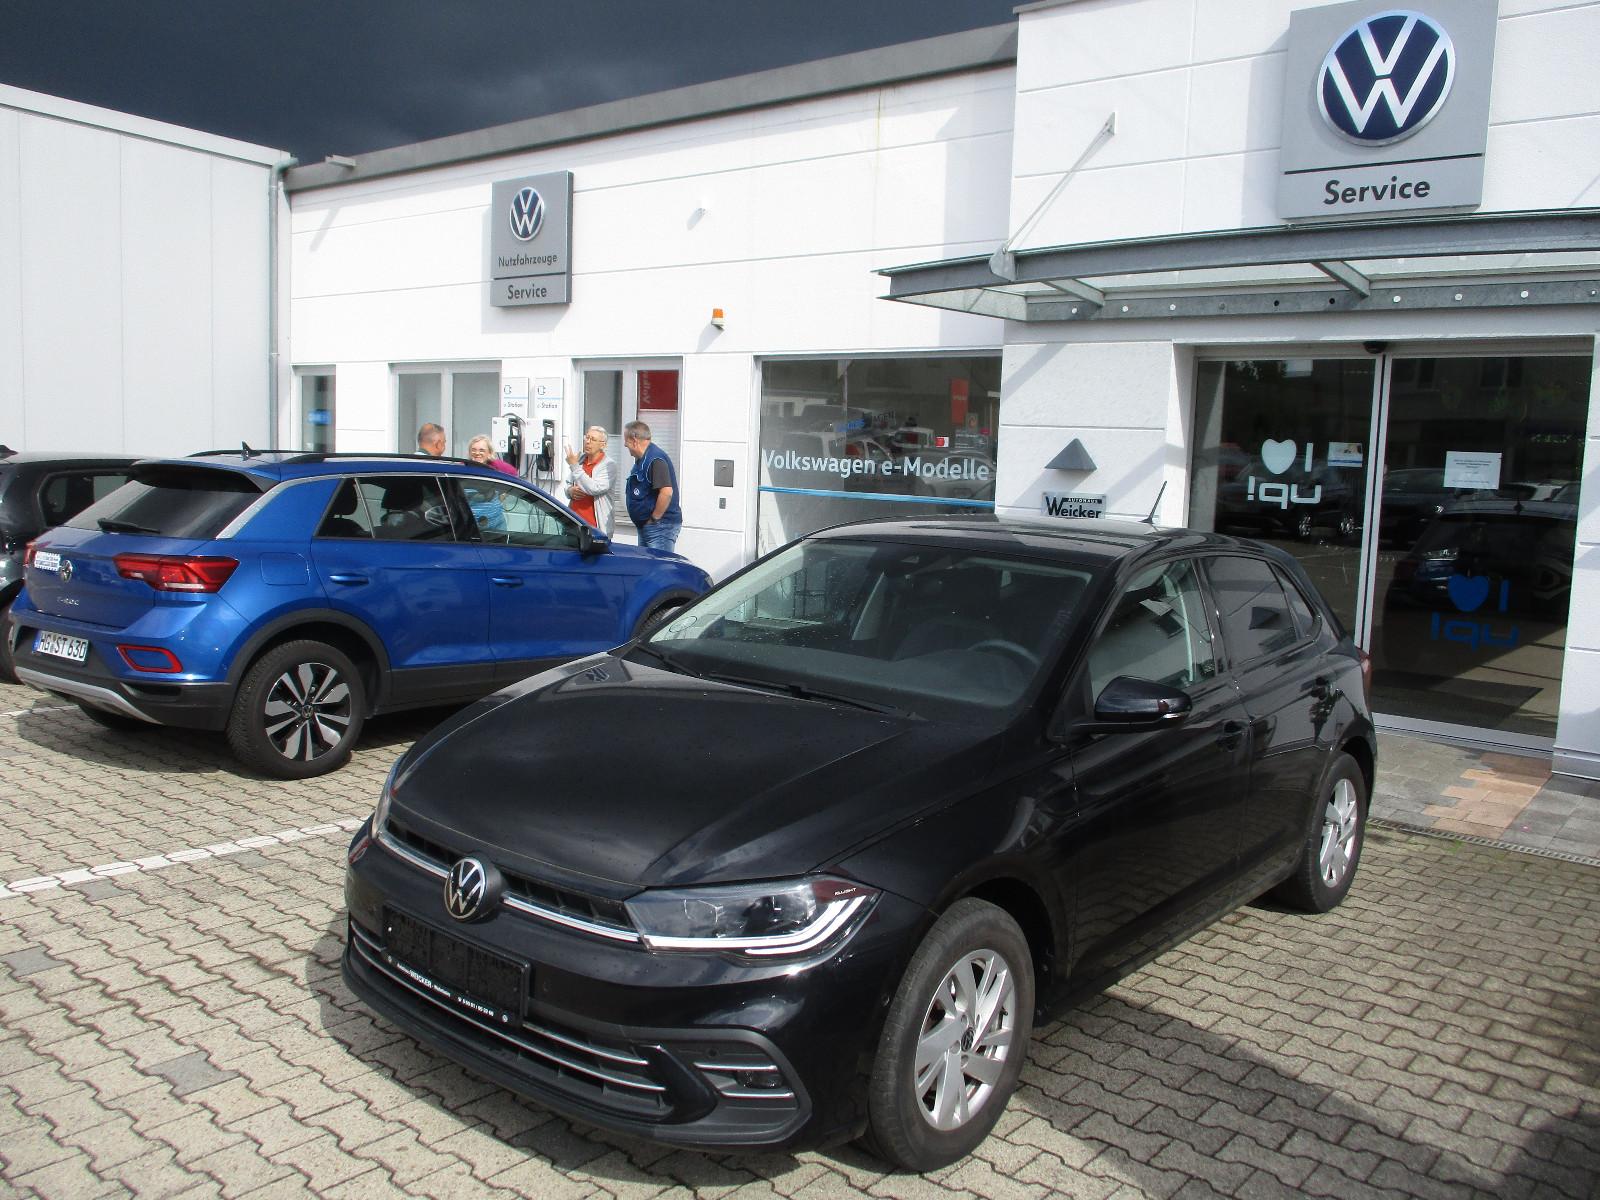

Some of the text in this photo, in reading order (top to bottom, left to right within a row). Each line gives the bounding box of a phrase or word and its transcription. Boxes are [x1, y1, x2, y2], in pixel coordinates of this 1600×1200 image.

[1323, 176, 1431, 205] Service
[498, 253, 558, 268] Nutzfahrzeuge
[507, 283, 548, 300] Service
[762, 450, 990, 481] Volkswagen e-Modelle
[1045, 496, 1102, 519] Weicker
[55, 636, 68, 655] ST
[68, 639, 87, 659] 630
